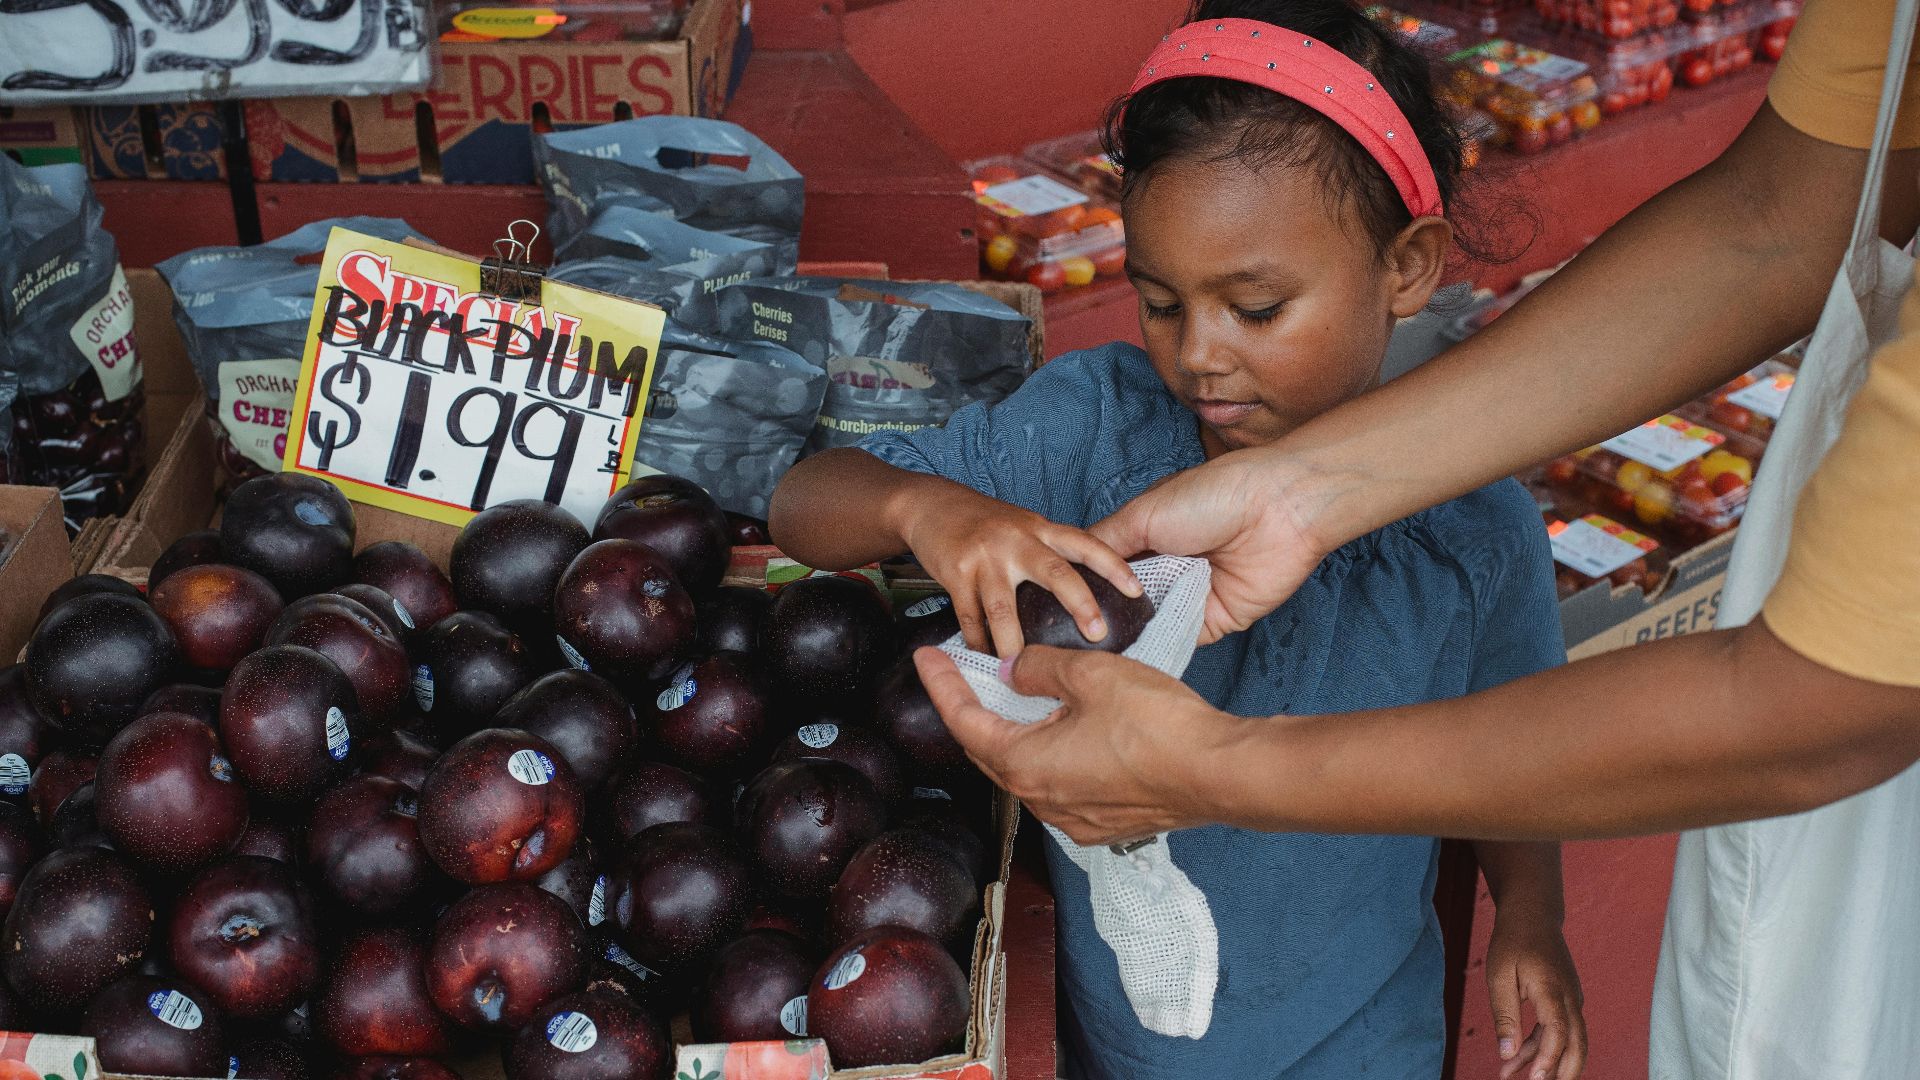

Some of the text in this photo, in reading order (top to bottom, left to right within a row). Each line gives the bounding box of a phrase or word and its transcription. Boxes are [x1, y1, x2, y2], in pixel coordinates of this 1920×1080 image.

[15, 261, 80, 315] moments
[752, 302, 793, 324] Cherries
[753, 320, 788, 342] Cerises
[233, 399, 293, 429] CHE
[307, 350, 586, 512] $1.99
